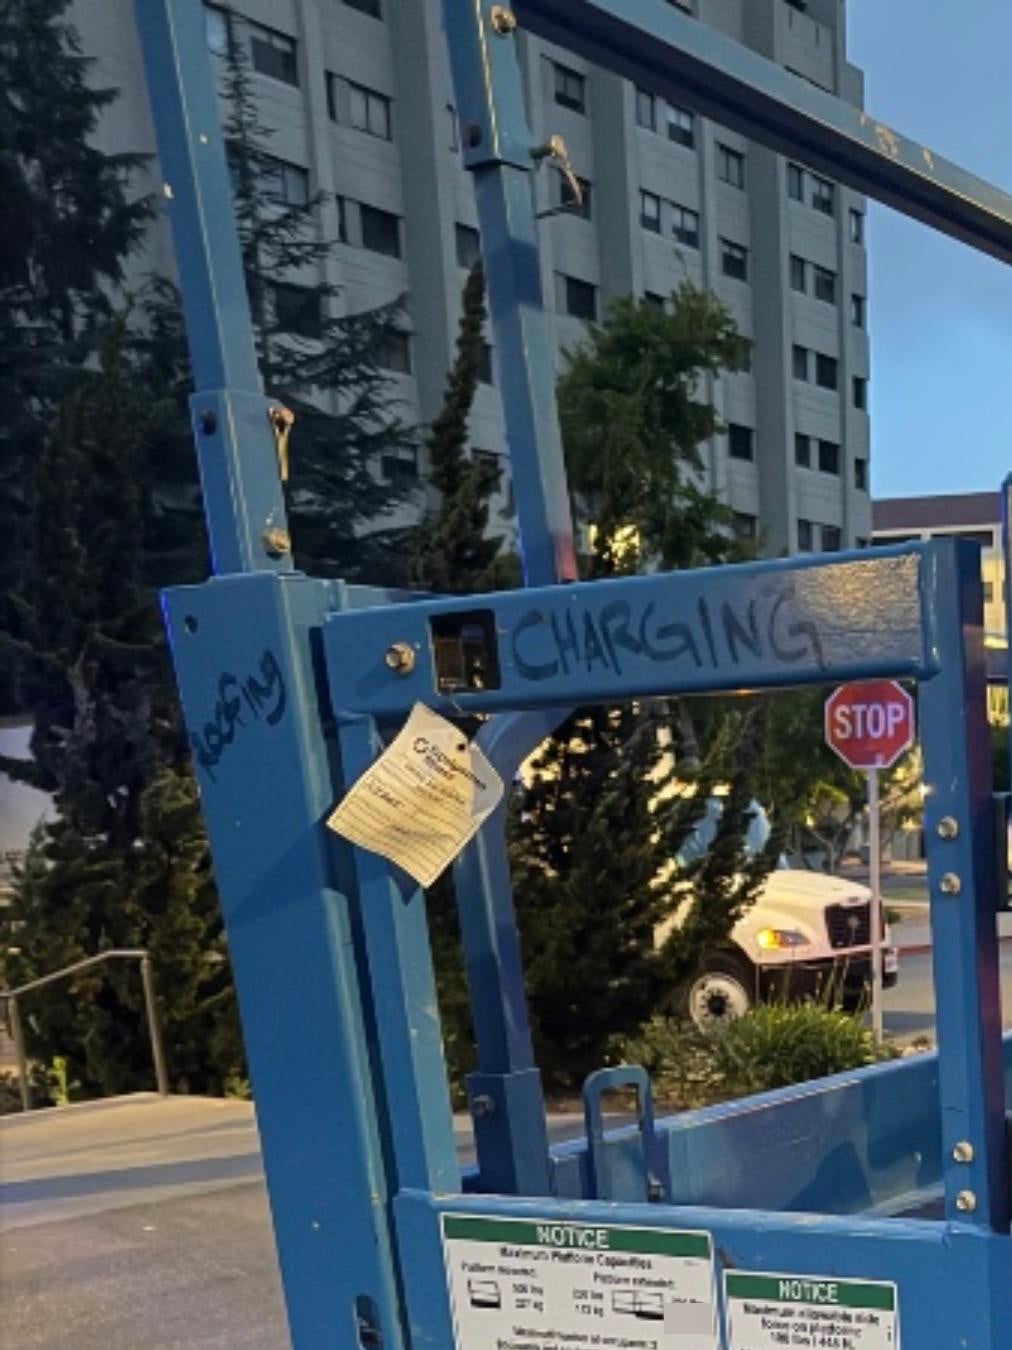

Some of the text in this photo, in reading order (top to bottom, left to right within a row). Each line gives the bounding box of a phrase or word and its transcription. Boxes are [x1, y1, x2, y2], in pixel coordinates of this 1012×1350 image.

[512, 586, 827, 681] CHARGING
[834, 702, 905, 739] STOP
[536, 1224, 610, 1249] NOTICE
[779, 1280, 839, 1303] NOTICE
